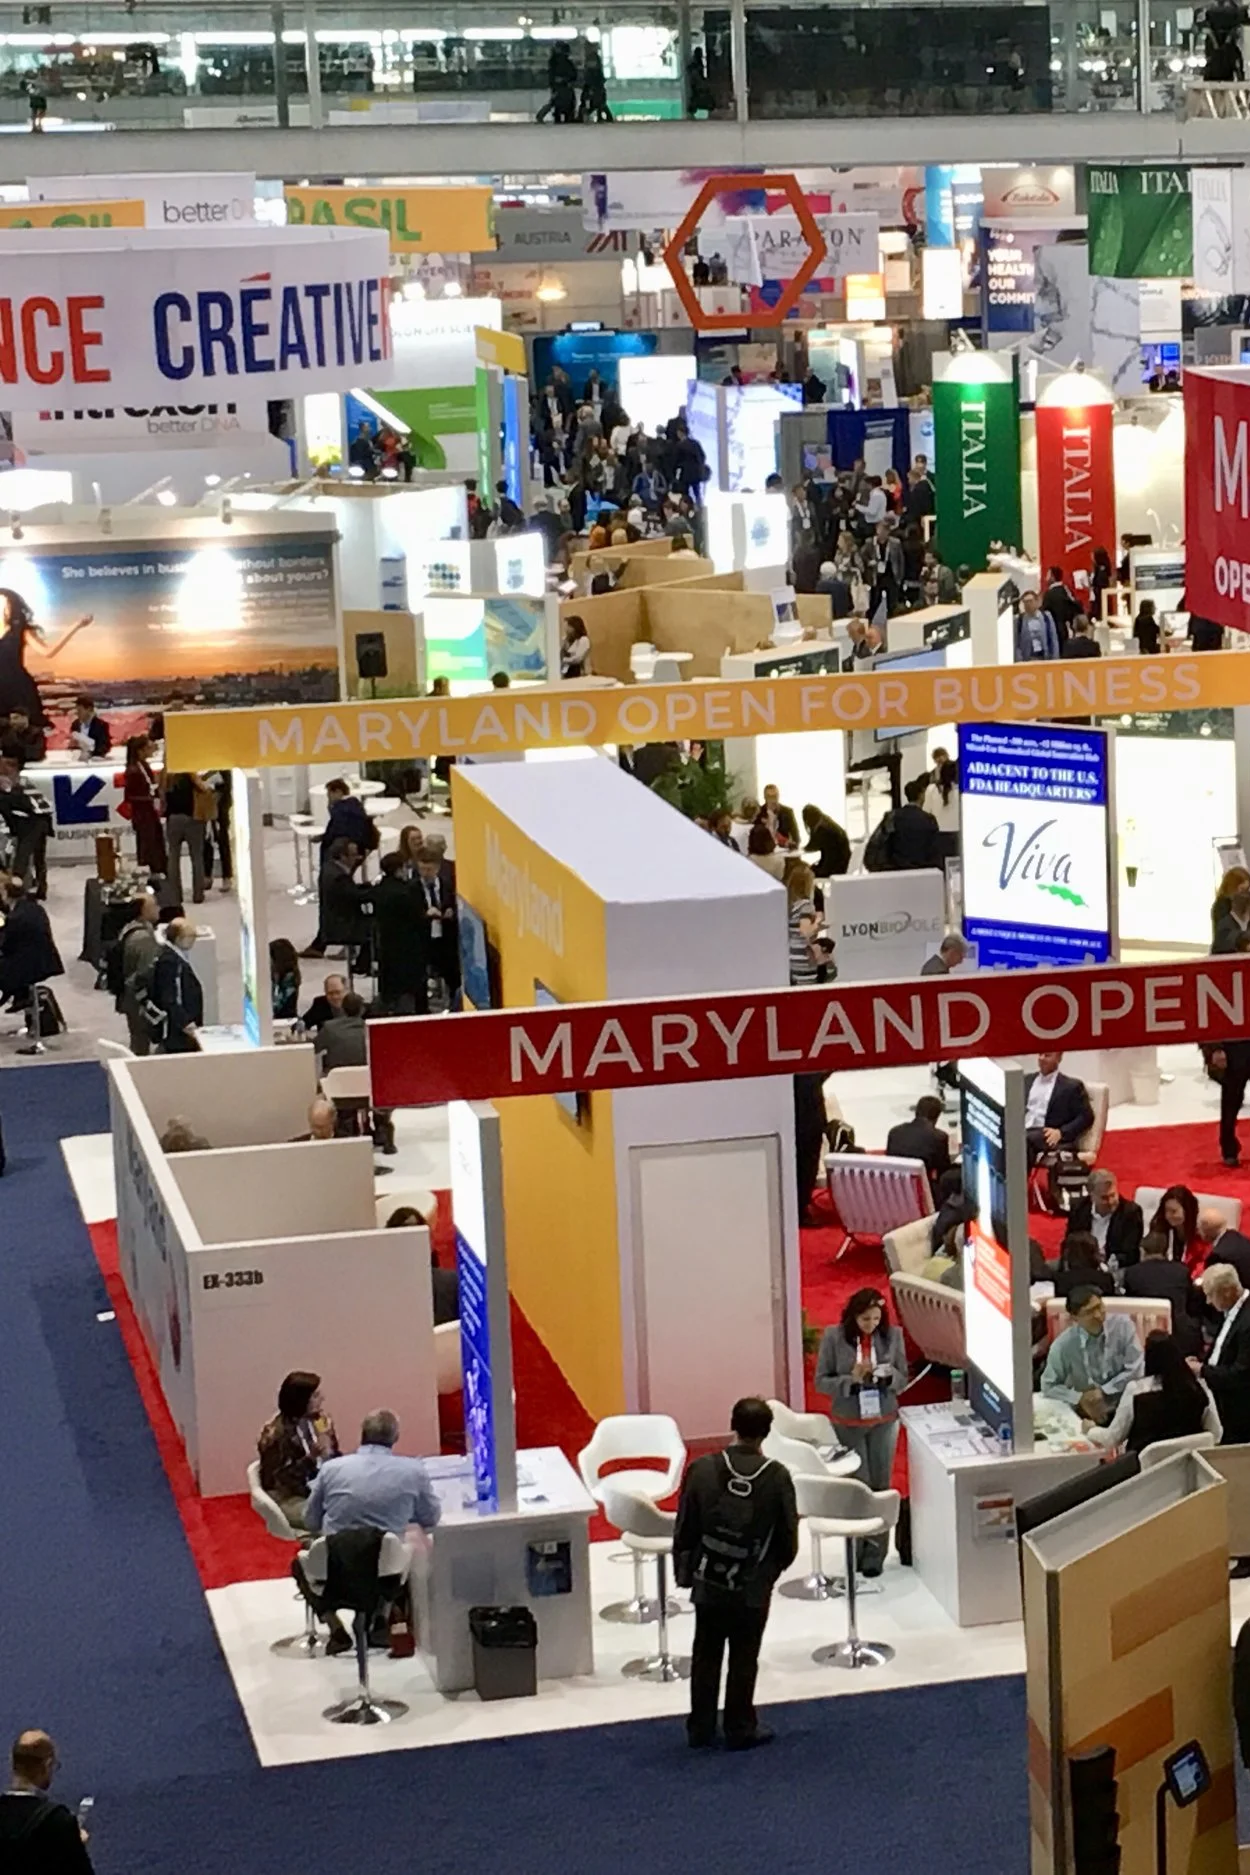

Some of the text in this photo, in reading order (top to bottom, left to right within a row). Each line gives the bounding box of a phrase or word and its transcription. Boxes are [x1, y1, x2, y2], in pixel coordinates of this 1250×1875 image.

[1090, 171, 1119, 194] ITALIA
[163, 200, 228, 223] better
[514, 231, 572, 246] AUSTRIA
[988, 278, 1016, 290] OUR
[147, 417, 241, 434] better DNA
[960, 400, 988, 519] ITALIA
[1062, 426, 1093, 553] ITALIA
[61, 565, 86, 580] She
[88, 564, 139, 578] believes
[143, 563, 155, 574] in
[246, 569, 329, 585] about yours?
[258, 662, 1201, 758] MARYLAND OPEN FOR BUSINESS
[967, 761, 1099, 785] ADJACENT TO THE U.S.
[968, 778, 993, 791] FDA
[982, 818, 1073, 890] Viva
[484, 824, 564, 957] Maryland
[510, 990, 990, 1083] MARYLAND
[1021, 970, 1245, 1040] OPEN
